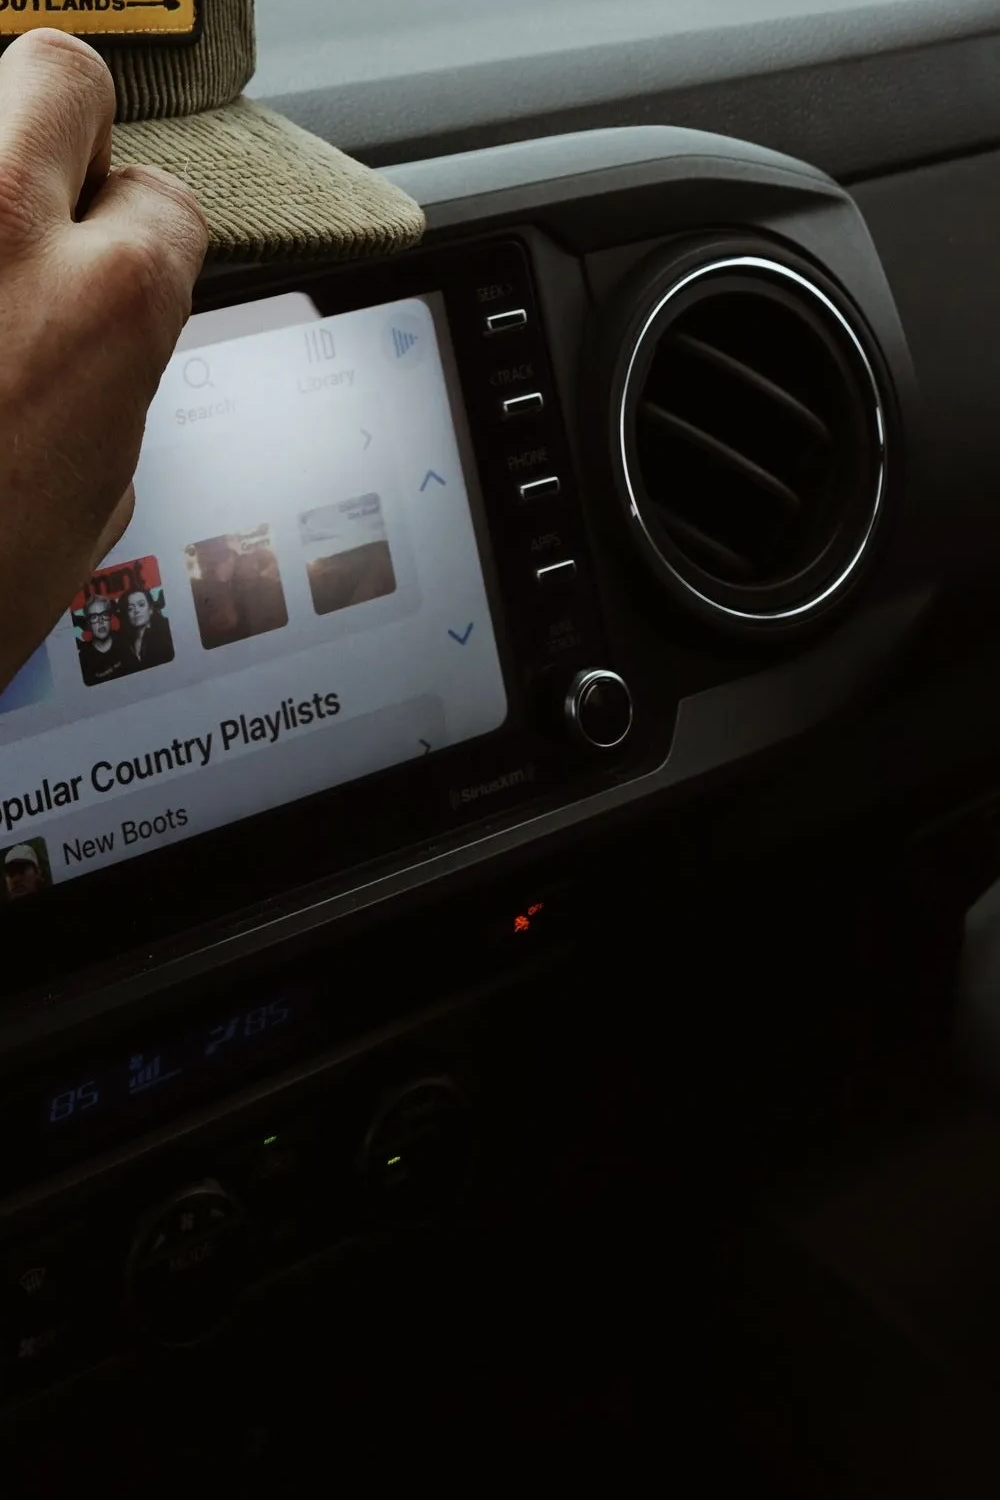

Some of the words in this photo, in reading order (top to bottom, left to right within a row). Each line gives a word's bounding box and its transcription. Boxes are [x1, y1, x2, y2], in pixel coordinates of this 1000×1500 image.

[175, 398, 236, 426] Search
[90, 731, 213, 793] Country
[220, 692, 341, 751] Playlists
[63, 832, 114, 866] New
[122, 805, 189, 846] Boots
[50, 1080, 99, 1123] 85
